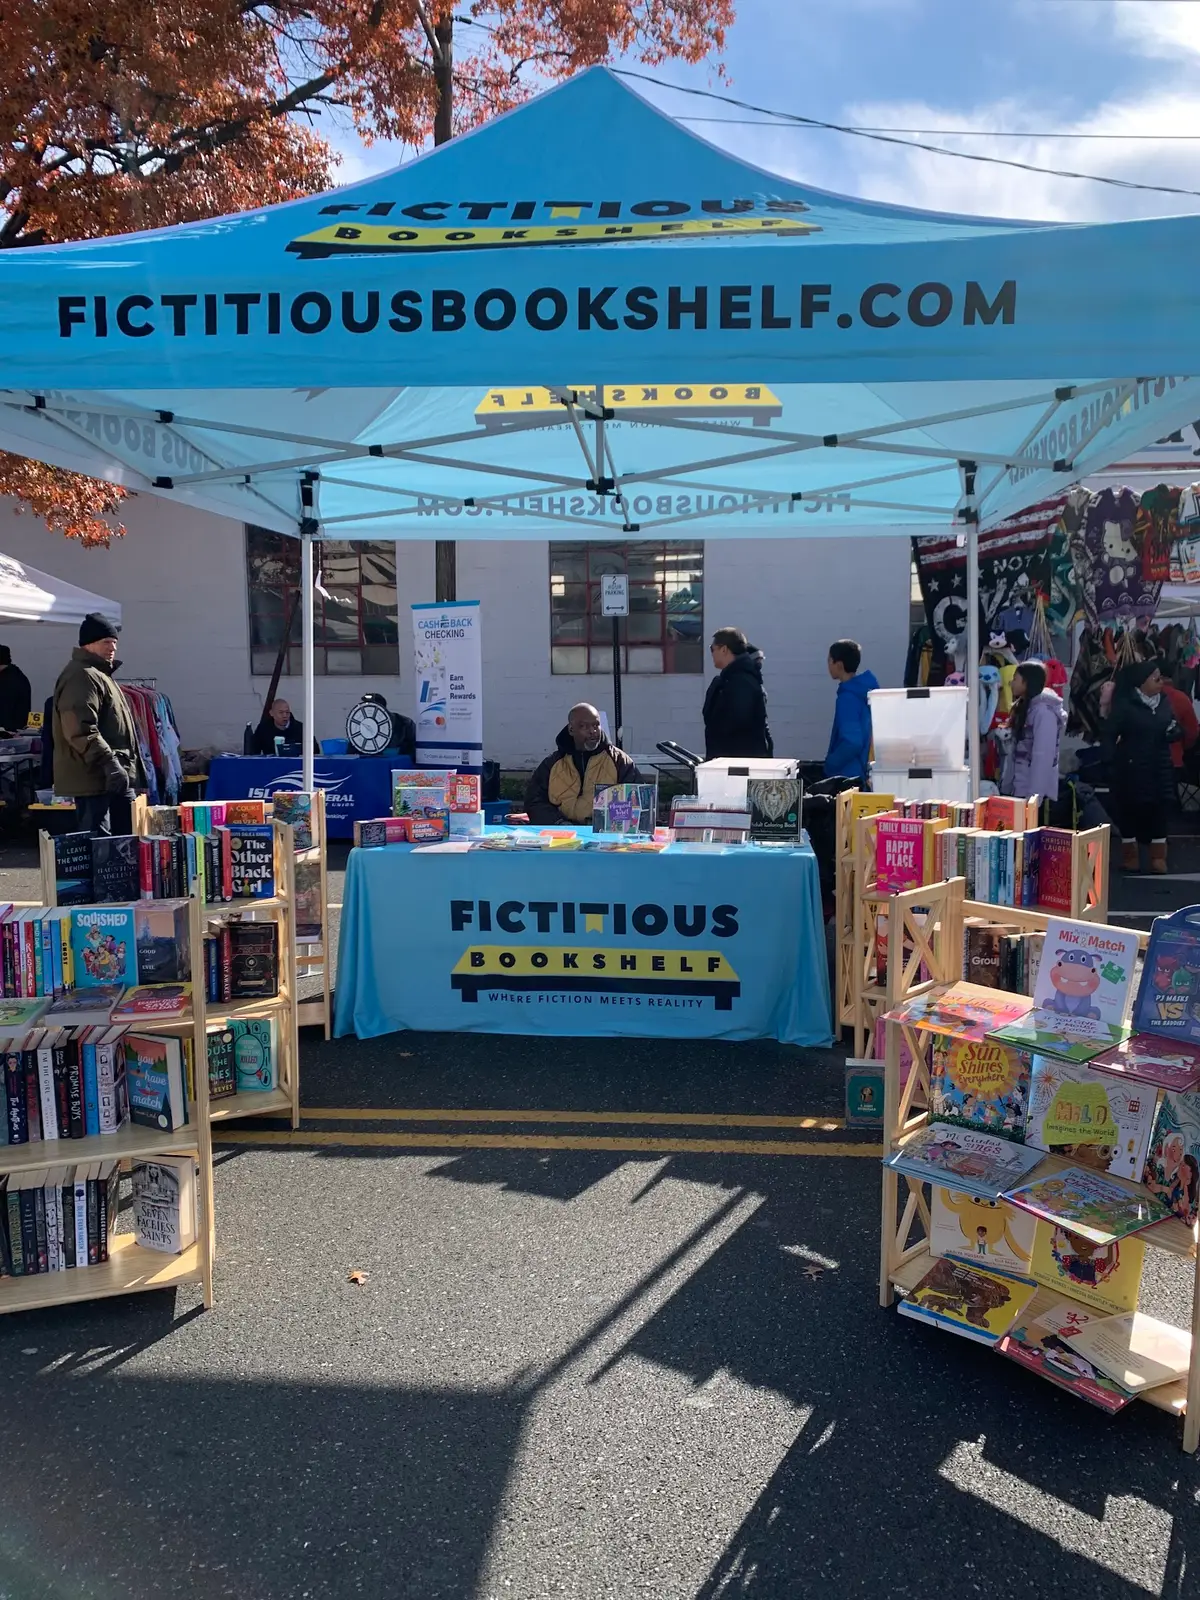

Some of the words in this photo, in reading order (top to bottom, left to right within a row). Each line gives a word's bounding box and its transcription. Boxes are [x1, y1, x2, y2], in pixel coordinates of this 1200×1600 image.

[318, 199, 810, 219] FICTITIOUS
[333, 219, 784, 240] BOOKSHELF
[58, 279, 1017, 338] FICTITIOUSBOOKSHELF.COM
[418, 619, 439, 629] CASH
[450, 618, 473, 628] BACK
[424, 629, 465, 639] CHECKING
[450, 683, 465, 691] Cash
[450, 692, 476, 700] Rewards
[326, 794, 355, 802] ERAL
[236, 804, 261, 812] COURT
[879, 822, 899, 832] EMILY
[244, 839, 266, 850] The
[886, 840, 915, 854] HAPPY
[1041, 837, 1072, 846] CHRISTIN
[66, 846, 88, 855] LEAVE
[231, 850, 272, 863] Other
[72, 855, 91, 863] WOR
[886, 853, 914, 868] PLACE
[64, 864, 90, 873] BEHIND
[231, 865, 272, 878] Black
[450, 900, 740, 938] FICTITIOUS
[1059, 930, 1080, 944] Mix
[1088, 935, 1126, 953] Match
[470, 951, 722, 973] BOOKSHELF
[488, 992, 532, 1005] WHERE
[538, 995, 593, 1004] FICTION
[600, 996, 642, 1006] MEETS
[648, 997, 704, 1009] REALITY
[1156, 1002, 1186, 1020] VS
[207, 1043, 233, 1056] OUSE
[964, 1042, 1000, 1060] Sun
[137, 1055, 154, 1066] you
[959, 1059, 1003, 1074] Shines
[69, 1065, 79, 1099] PROMISE
[144, 1071, 168, 1086] have
[959, 1073, 1005, 1087] Everywhere
[213, 1084, 233, 1093] REYES
[132, 1095, 162, 1109] match
[71, 1101, 81, 1120] BOYS
[1046, 1123, 1077, 1134] Imagines
[1079, 1127, 1091, 1135] the
[1093, 1127, 1115, 1137] World
[963, 1135, 1001, 1146] Ciudad
[141, 1204, 168, 1221] SEVEN
[137, 1215, 176, 1234] FACELESS
[140, 1229, 172, 1245] SAINTS
